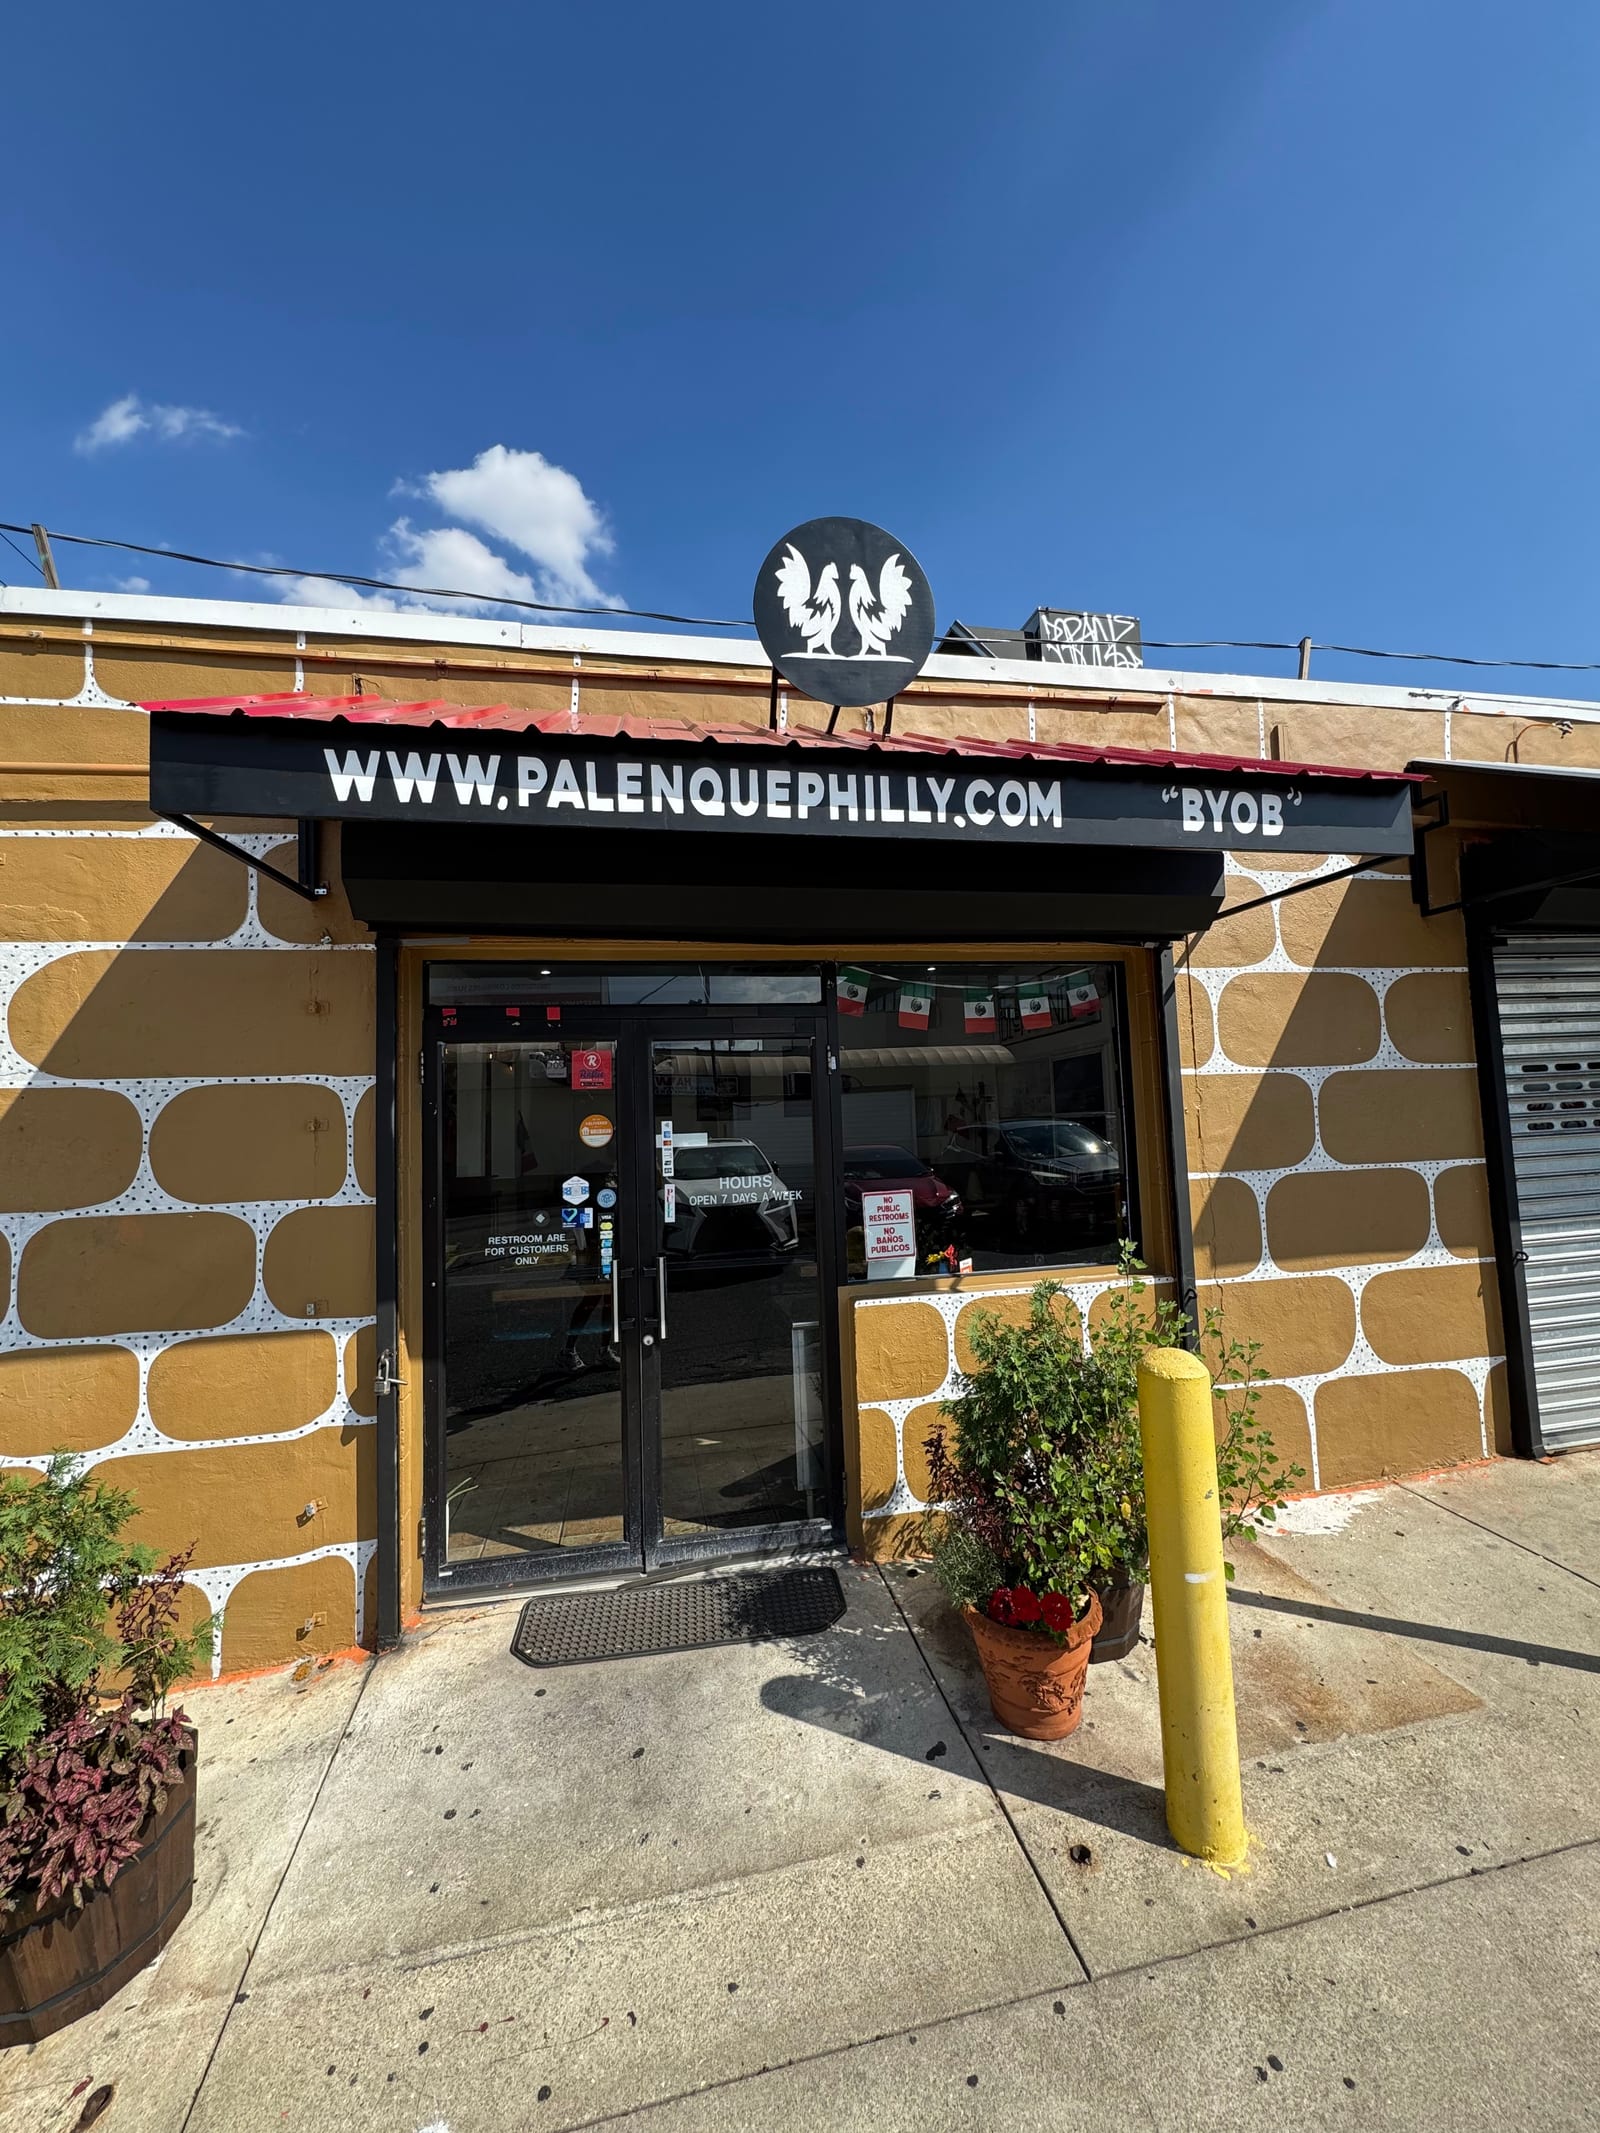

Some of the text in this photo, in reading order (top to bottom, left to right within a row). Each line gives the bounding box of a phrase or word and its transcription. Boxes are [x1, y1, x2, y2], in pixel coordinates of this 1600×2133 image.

[323, 748, 1063, 828] WWW.PALENQUEPHILLY.COM
[719, 1175, 773, 1190] HOURS
[689, 1190, 803, 1206] OPEN 7 DAYS A WEEK
[883, 1196, 893, 1204] NO
[877, 1204, 901, 1213] PUBLIC
[869, 1213, 910, 1222] RESTROOMS
[883, 1227, 895, 1235] NO
[488, 1233, 566, 1245] RESTROOM ARE
[484, 1244, 569, 1256] FOR CUSTOMERS
[871, 1244, 910, 1254] PUBLICOS
[515, 1256, 540, 1266] ONLY
